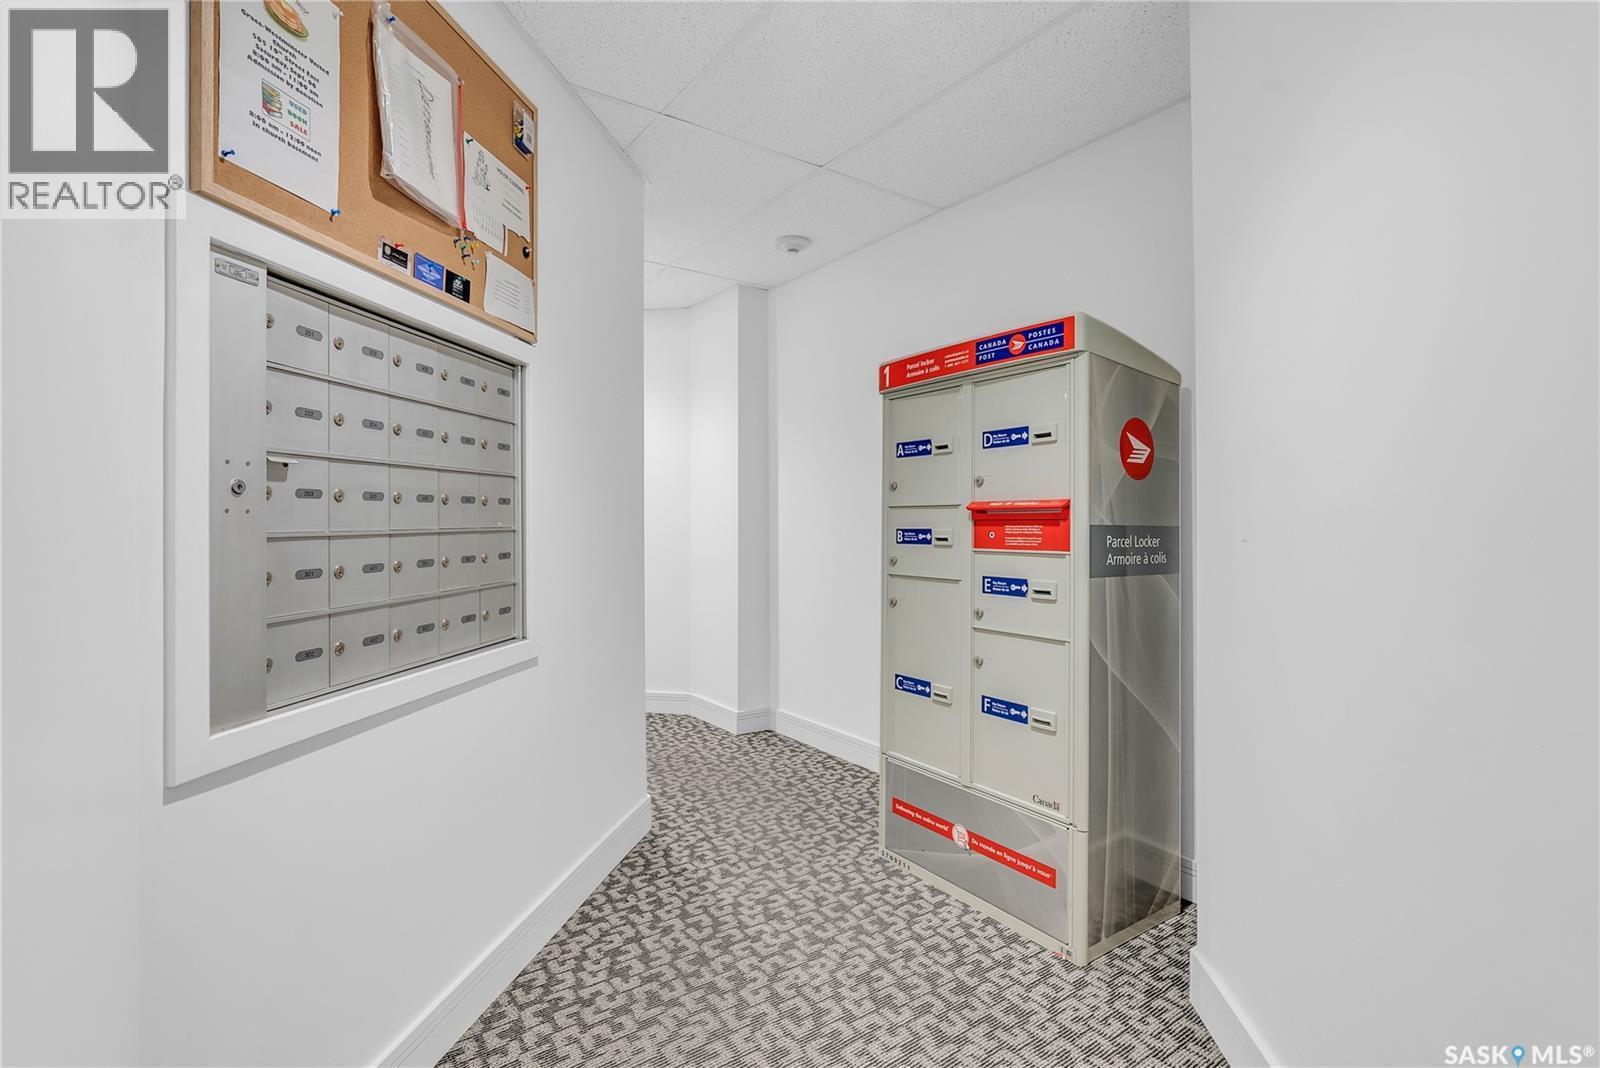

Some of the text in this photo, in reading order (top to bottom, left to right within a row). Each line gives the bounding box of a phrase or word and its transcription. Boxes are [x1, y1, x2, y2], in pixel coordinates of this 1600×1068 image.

[273, 40, 296, 59] Church
[253, 33, 266, 46] 505
[285, 55, 305, 73] Street
[307, 71, 319, 83] East
[309, 57, 329, 75] United
[248, 54, 323, 108] Admission by donation
[272, 63, 282, 73] am
[310, 90, 318, 98] am
[289, 100, 307, 116] USED
[288, 109, 307, 126] BOOK
[290, 121, 308, 136] SALE
[262, 126, 286, 144] church
[288, 139, 318, 163] basement
[268, 122, 279, 132] am
[306, 144, 322, 157] noon
[1028, 328, 1056, 339] POSTES
[979, 339, 1007, 350] CANADA
[1028, 338, 1060, 350] CANADA
[906, 361, 919, 370] Parcel
[920, 358, 934, 366] locker
[906, 369, 924, 378] Armoire
[929, 364, 940, 373] colis
[883, 366, 890, 387] 1
[984, 433, 992, 446] D
[897, 444, 904, 456] A
[897, 531, 903, 542] B
[1107, 535, 1160, 548] Parcel Locker
[1106, 552, 1167, 565] Armoire à colis
[984, 579, 991, 592] E
[896, 677, 903, 689] C
[984, 698, 991, 712] F
[1032, 794, 1060, 812] Canada
[896, 803, 915, 817] Delivering
[922, 817, 934, 825] online
[979, 842, 996, 853] monde
[1004, 852, 1016, 863] ligne
